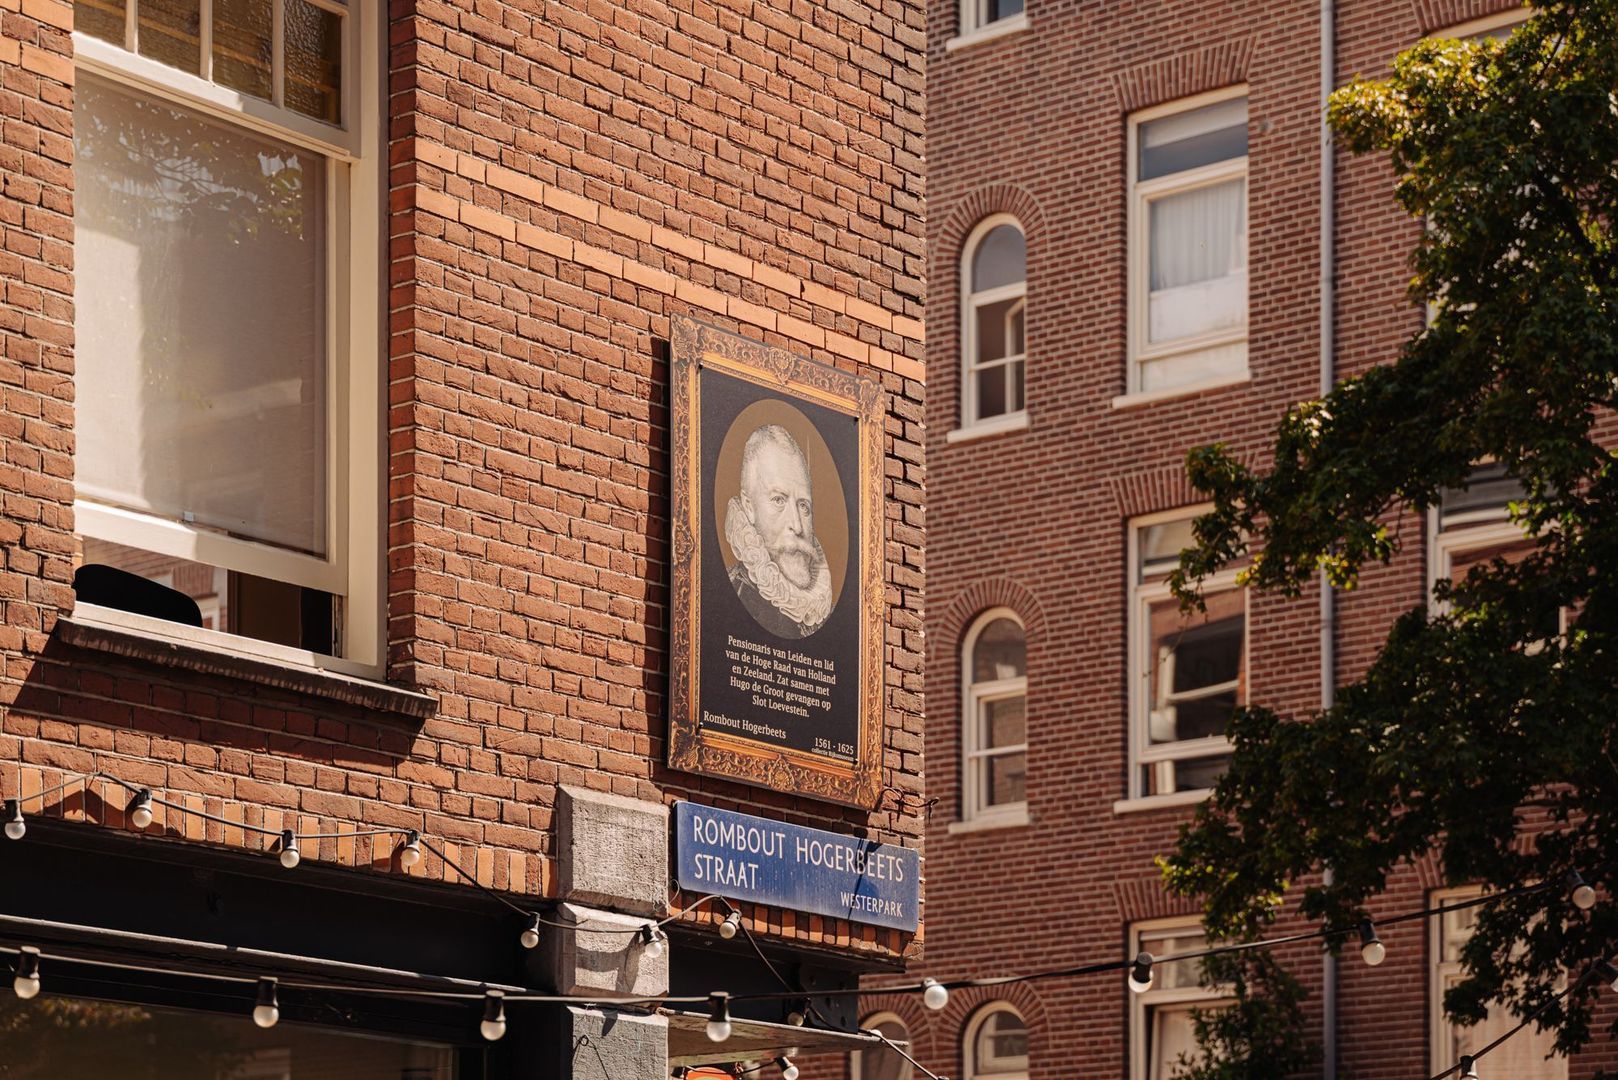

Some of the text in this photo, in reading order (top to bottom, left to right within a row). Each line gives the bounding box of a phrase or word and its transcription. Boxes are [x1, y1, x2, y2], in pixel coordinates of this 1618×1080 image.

[725, 650, 836, 685] van de Hoge Raad van Holland
[728, 635, 834, 671] Pensionaris van Leiden en lid
[730, 676, 831, 711] Hugo de Groot gevangen op
[732, 665, 830, 696] en Zeeland. Zat samen met
[752, 695, 810, 718] Slot Loevestein.
[703, 710, 787, 739] Rombout Hogerbeets
[815, 737, 831, 750] 1561
[837, 742, 854, 755] 1625
[693, 815, 904, 882] ROMBOUT HOGERBEETS
[694, 853, 759, 890] STRAAT
[840, 891, 903, 918] WESTERPARK
